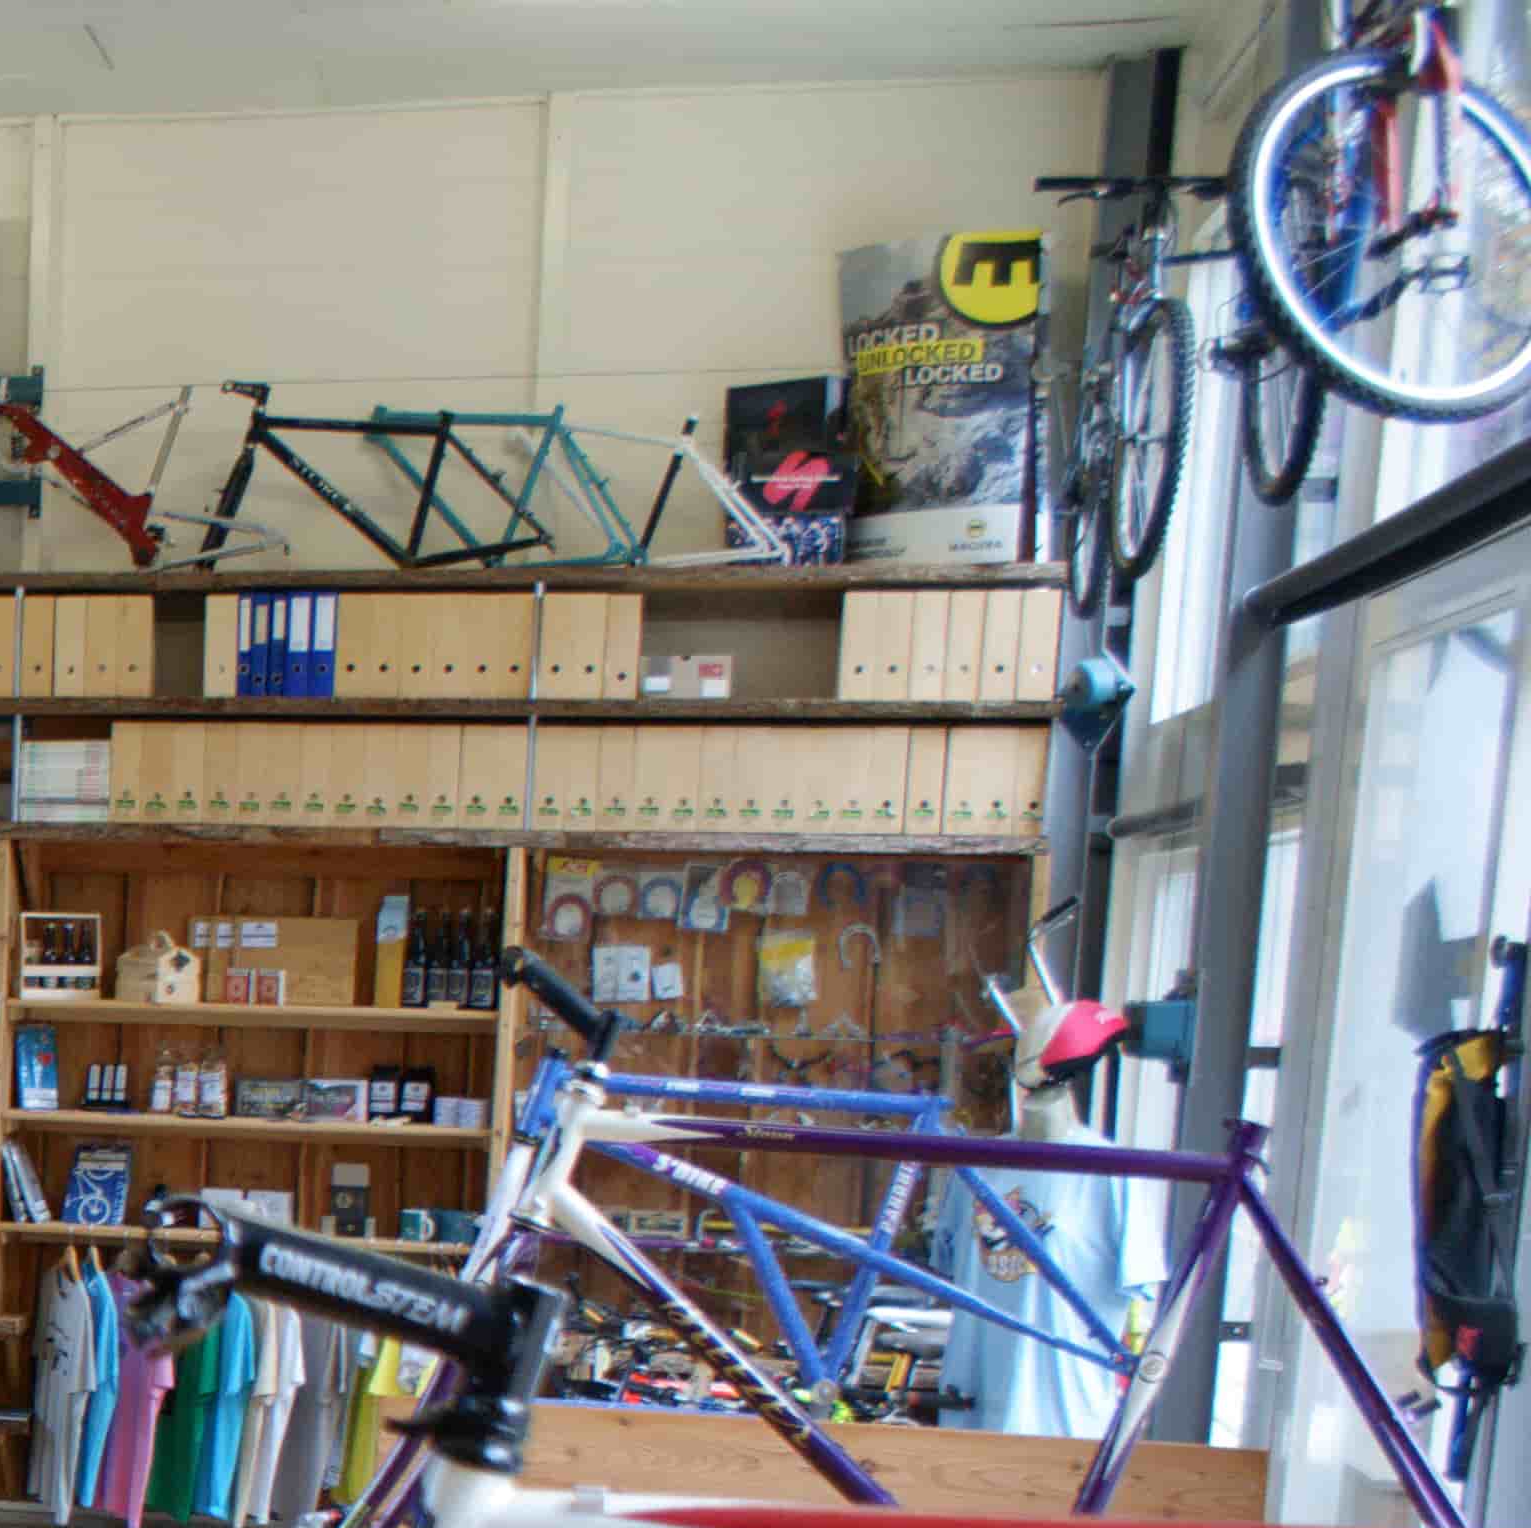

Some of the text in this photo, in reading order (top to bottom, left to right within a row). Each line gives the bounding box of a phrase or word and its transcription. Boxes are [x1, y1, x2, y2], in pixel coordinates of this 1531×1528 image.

[847, 322, 939, 353] LOCKED
[858, 342, 974, 372] UNLOCKED
[905, 363, 1003, 386] LOCKED
